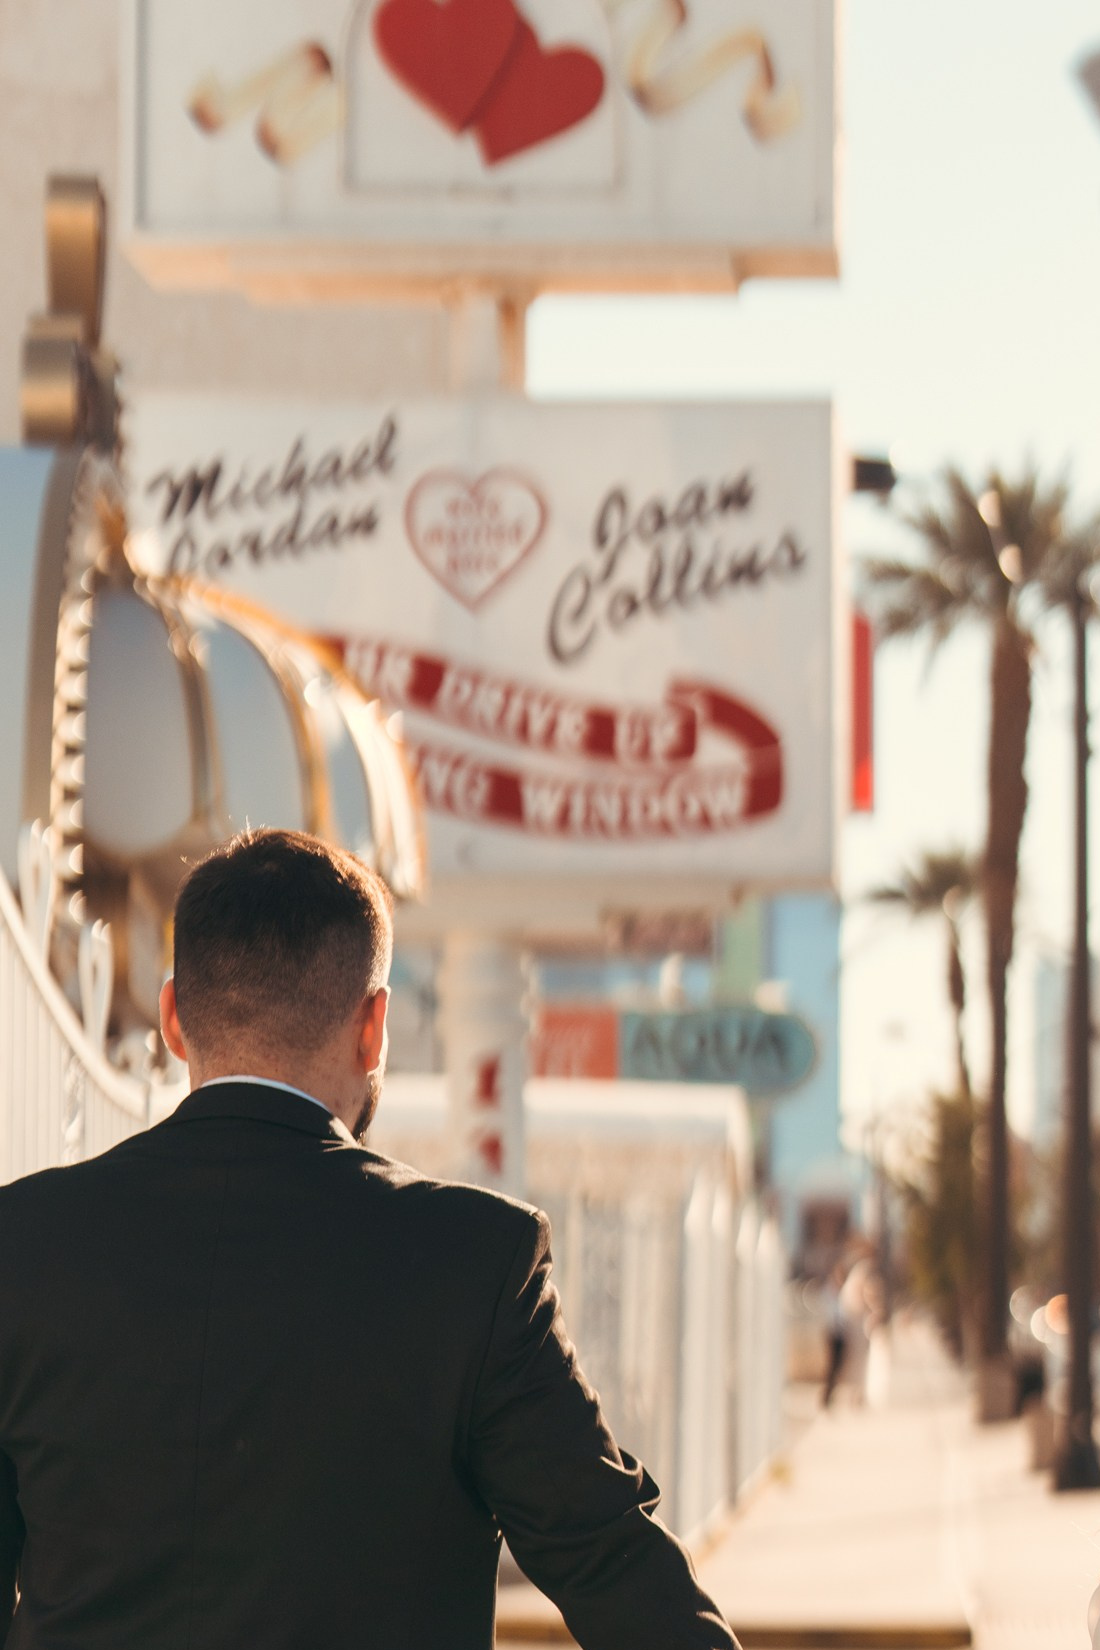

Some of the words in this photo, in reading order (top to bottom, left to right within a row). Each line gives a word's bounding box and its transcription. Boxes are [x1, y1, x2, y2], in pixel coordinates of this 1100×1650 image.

[146, 411, 397, 524] Michael
[594, 471, 753, 586] Joan
[546, 530, 806, 668] Collins
[435, 658, 588, 758] DRIVE
[613, 702, 682, 765] UP
[521, 765, 746, 840] WINDOW
